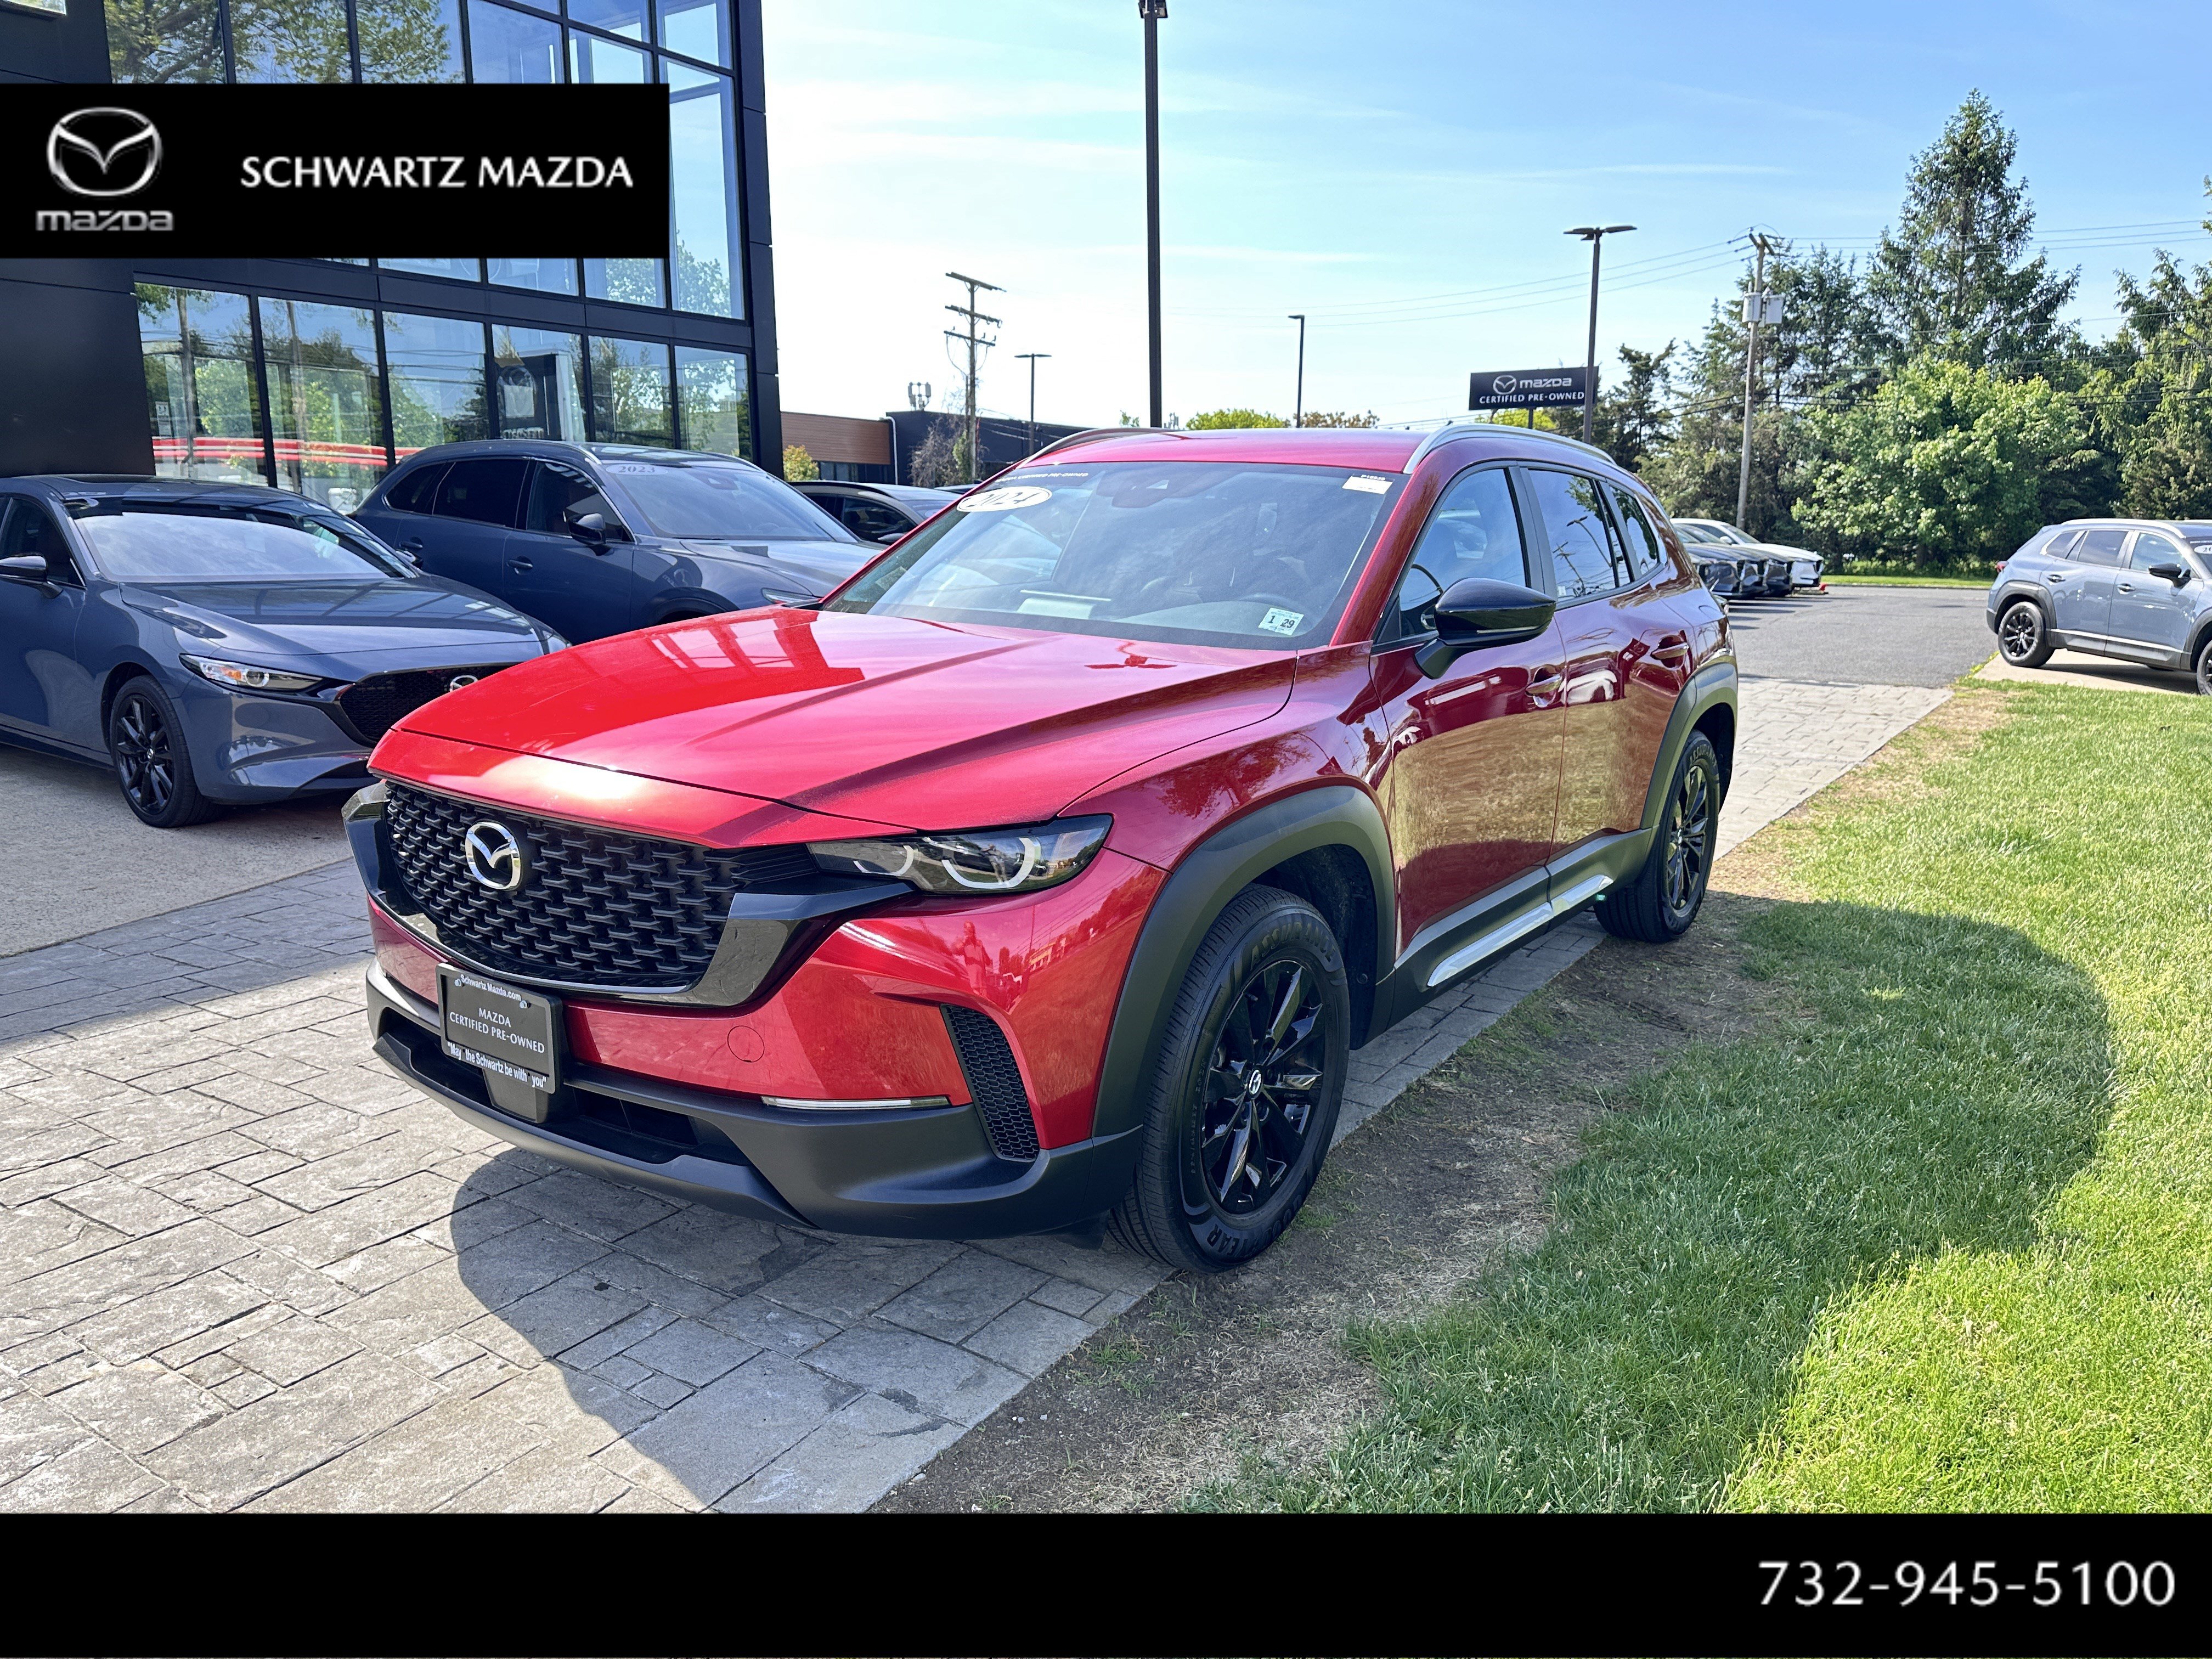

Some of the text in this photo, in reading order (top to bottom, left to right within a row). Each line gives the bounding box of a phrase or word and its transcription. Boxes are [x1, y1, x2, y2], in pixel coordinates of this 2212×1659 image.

[1520, 377, 1572, 388] mazda
[1479, 391, 1585, 404] CERTIFIED PRE-OWNED
[965, 492, 1042, 508] 2024
[1268, 615, 1276, 624] 1
[1279, 618, 1295, 628] 29
[478, 1007, 511, 1028] MAZDA
[449, 1012, 545, 1053] CERTIFIED PRE-OWNED
[465, 1049, 475, 1063] the
[476, 1052, 504, 1074] Schwartz
[504, 1064, 513, 1076] be
[514, 1068, 527, 1082] with
